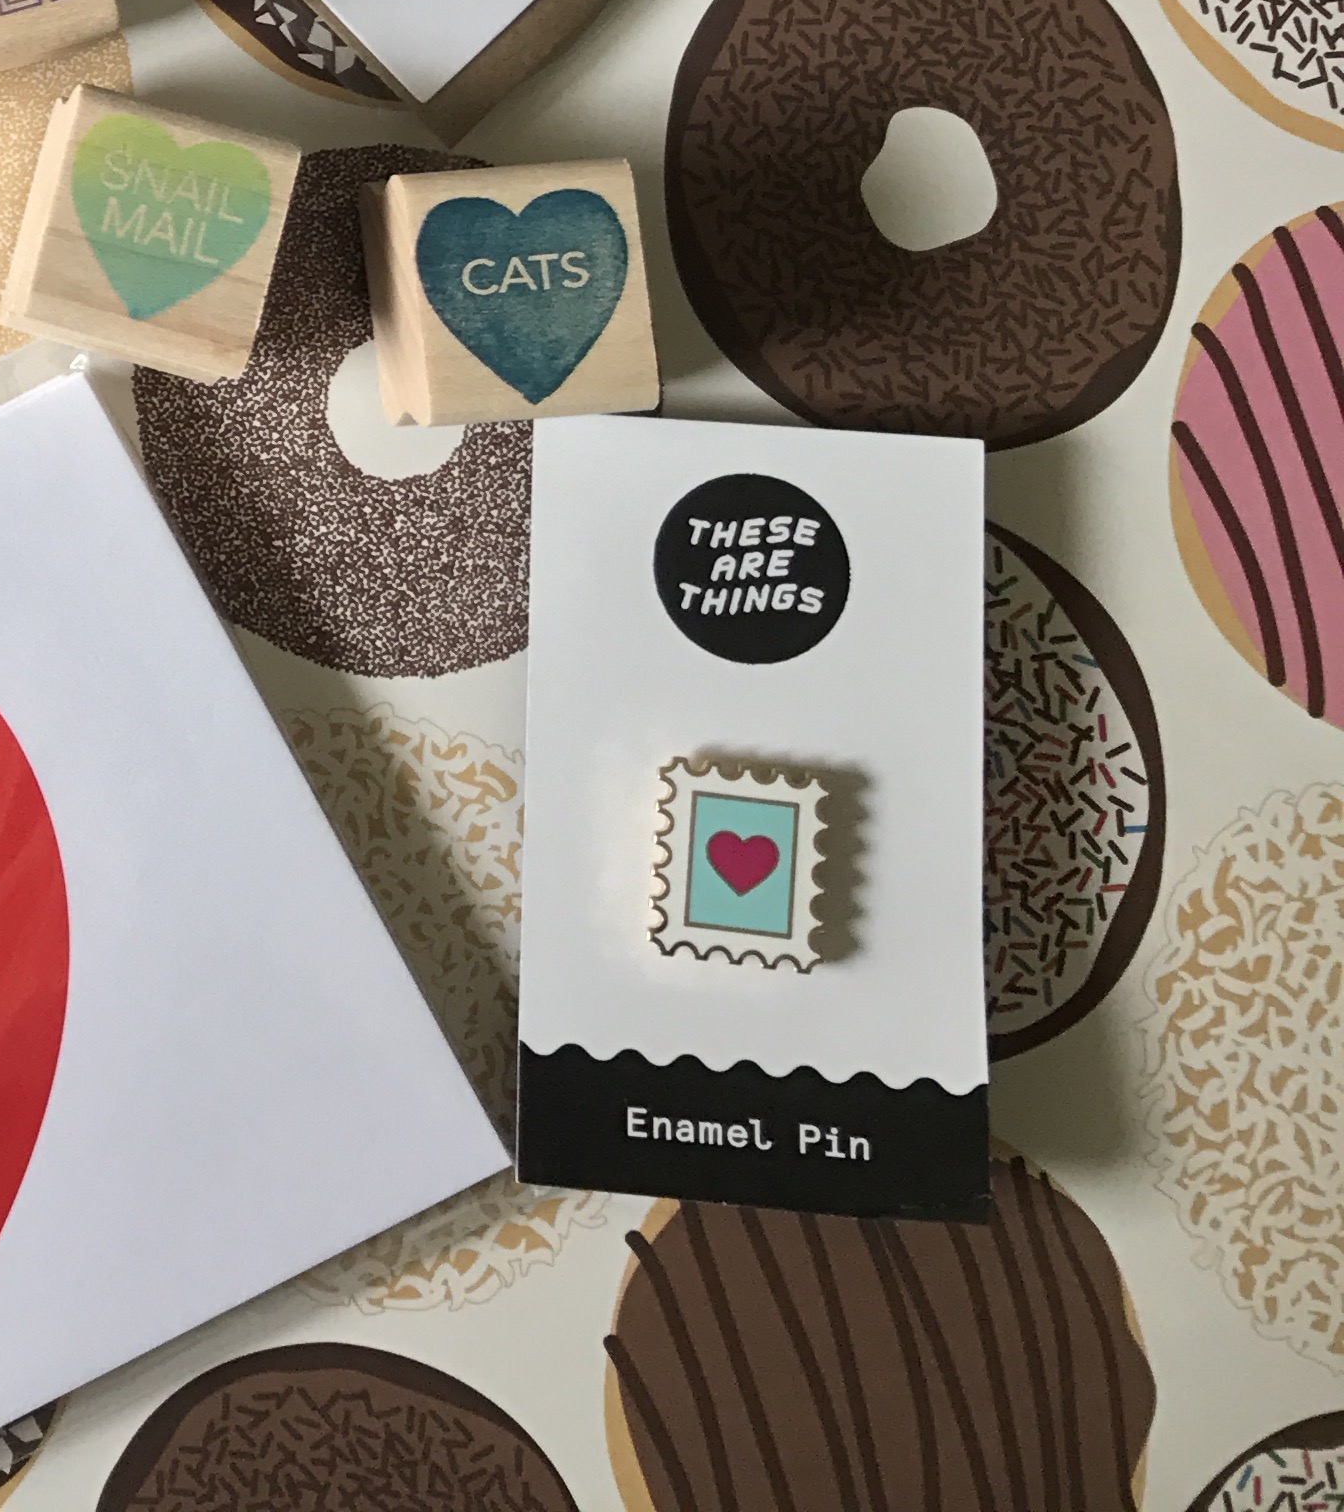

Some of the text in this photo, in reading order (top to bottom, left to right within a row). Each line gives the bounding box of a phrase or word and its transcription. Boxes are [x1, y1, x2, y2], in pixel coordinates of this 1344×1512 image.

[100, 147, 246, 226] SNAIL
[100, 197, 219, 268] MAIL
[461, 251, 591, 295] CATS
[688, 516, 821, 549] THESE
[711, 549, 794, 581] ARE
[680, 582, 825, 615] THINGS
[626, 1107, 872, 1162] Enamel Pin
